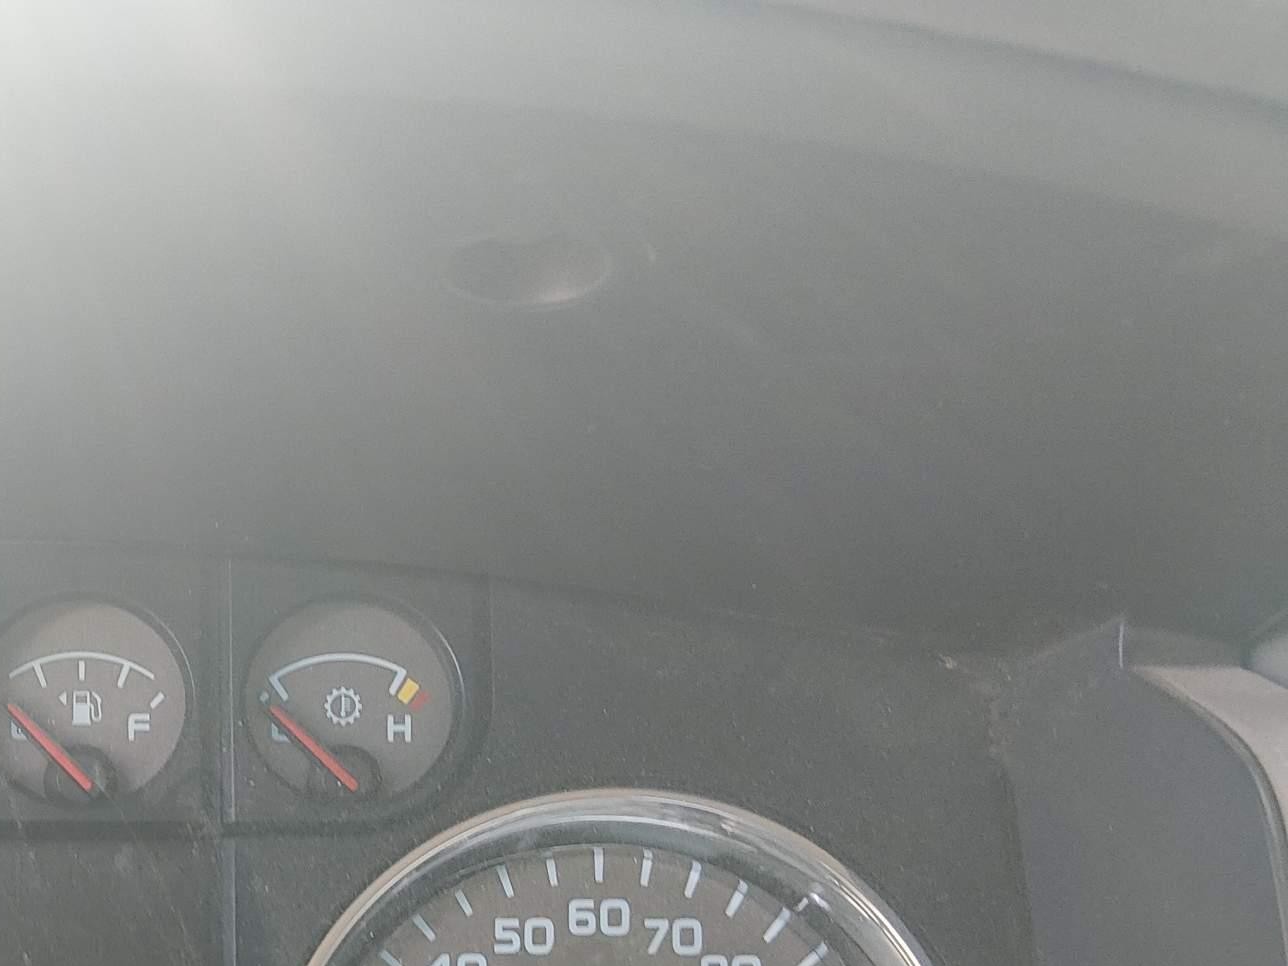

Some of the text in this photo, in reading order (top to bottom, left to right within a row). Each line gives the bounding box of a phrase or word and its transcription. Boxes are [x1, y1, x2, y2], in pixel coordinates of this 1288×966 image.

[128, 713, 151, 741] F
[387, 714, 412, 742] H
[493, 917, 555, 955] 50
[567, 898, 631, 936] 60
[643, 917, 703, 955] 70
